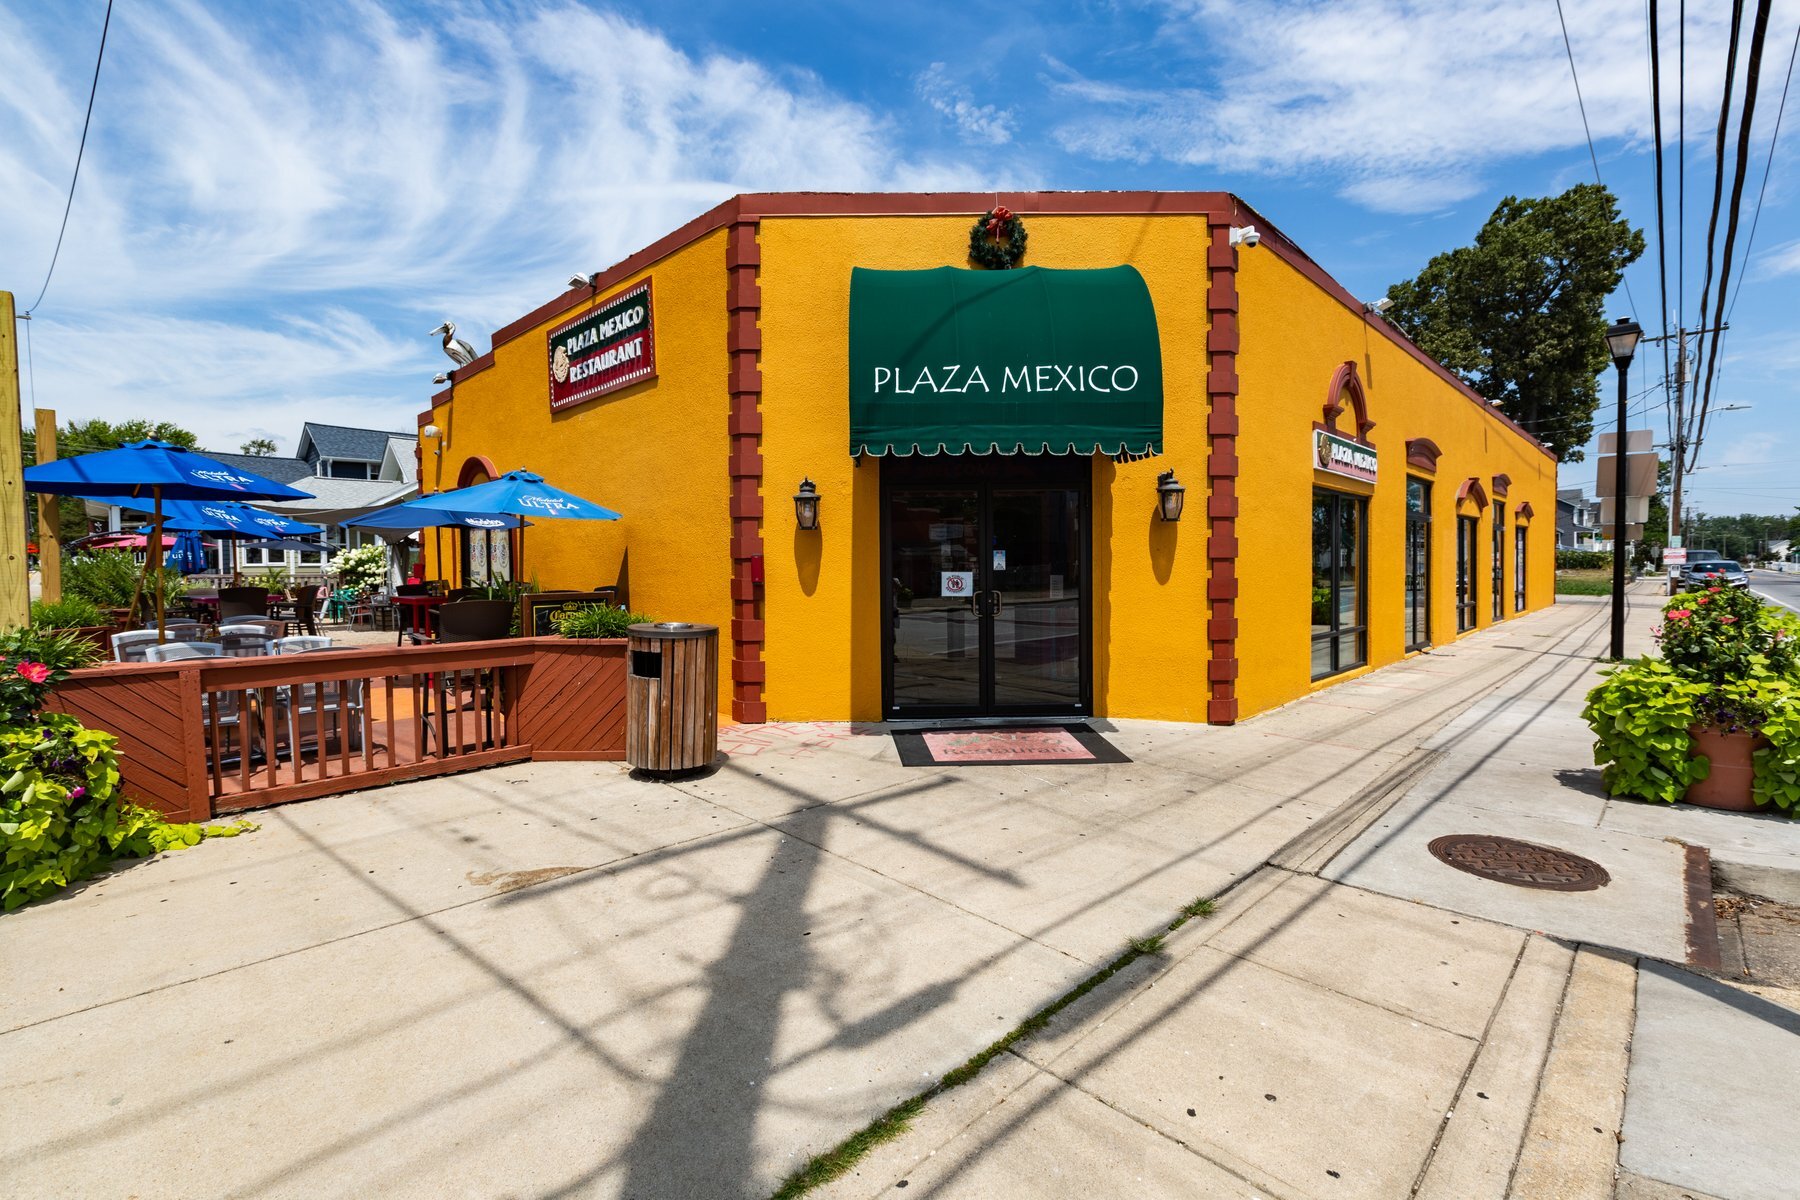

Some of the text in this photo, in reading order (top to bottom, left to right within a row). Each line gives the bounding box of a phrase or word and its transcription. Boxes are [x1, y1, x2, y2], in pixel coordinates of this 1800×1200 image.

[567, 306, 644, 355] PLAZA MEXICO
[569, 337, 643, 383] RESTAURANT
[874, 365, 1139, 394] PLAZA MEXICO
[1331, 443, 1353, 464] PLAZA
[190, 471, 254, 483] ULTRA
[518, 498, 580, 509] ULTRA
[201, 509, 242, 522] ULTRA
